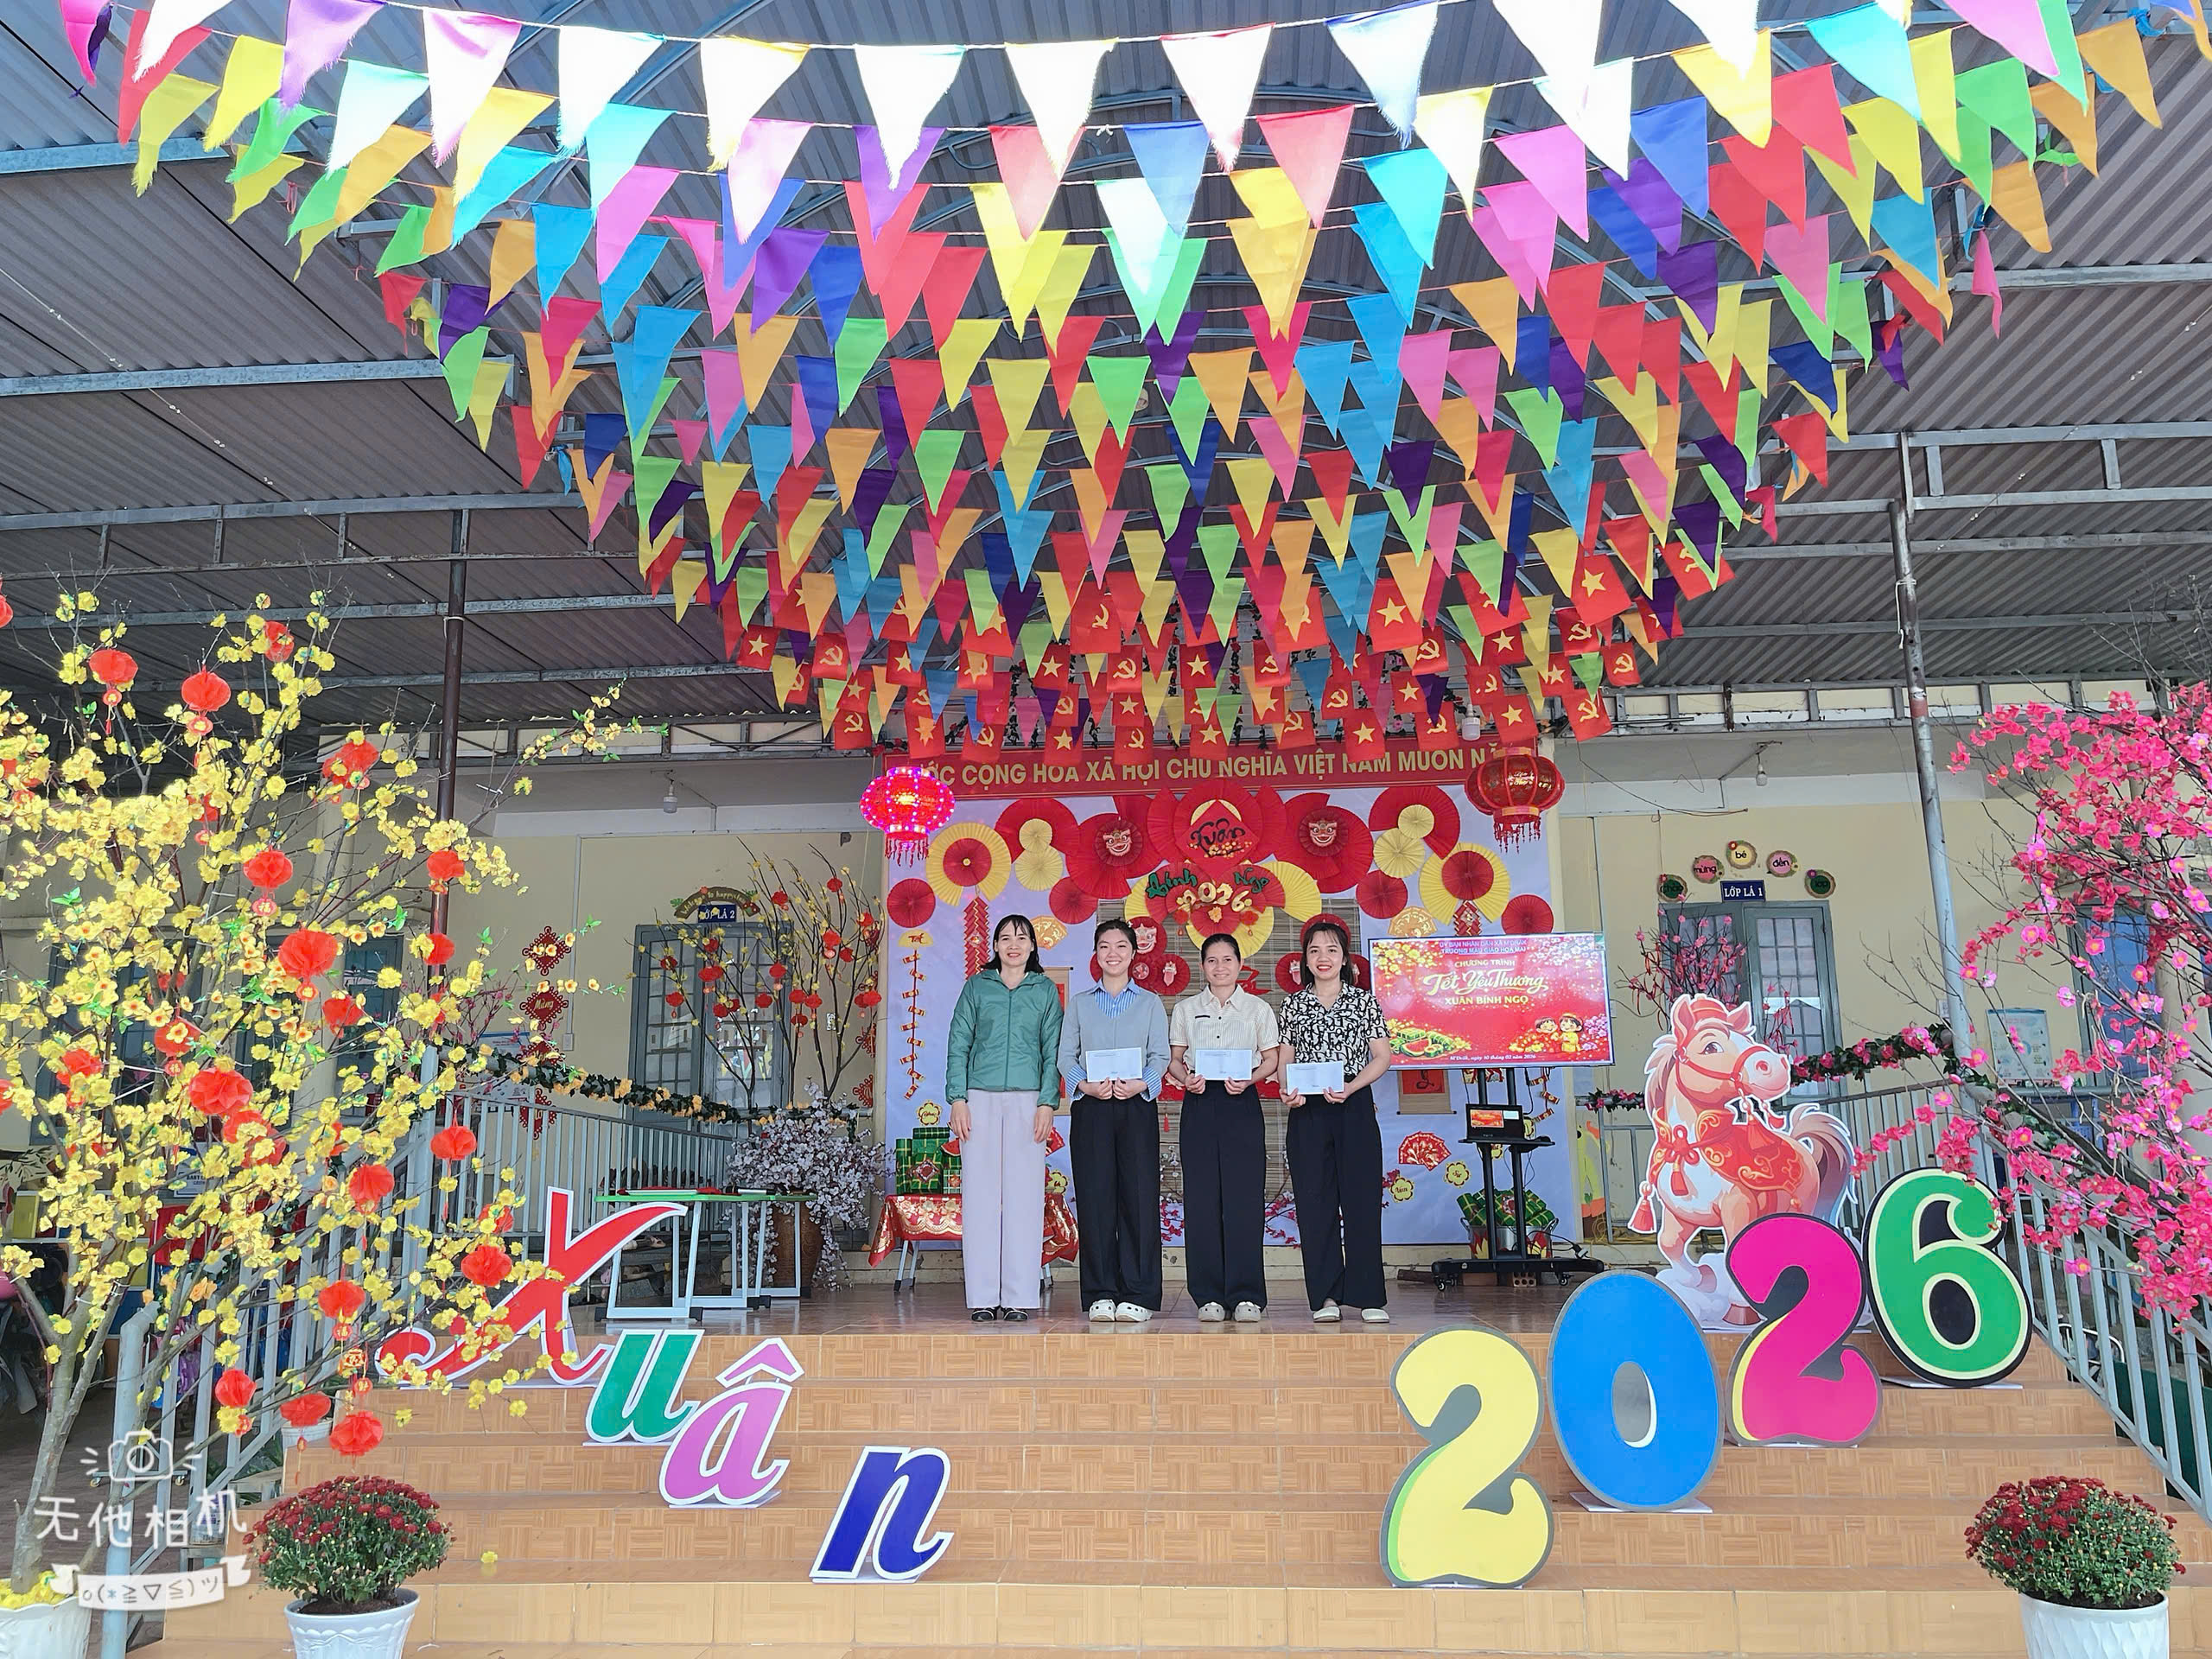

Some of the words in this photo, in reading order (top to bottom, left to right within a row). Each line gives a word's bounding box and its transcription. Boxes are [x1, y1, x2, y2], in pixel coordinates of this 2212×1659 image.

[1085, 756, 1116, 781] XÃ
[1218, 751, 1287, 777] NGHĨA
[1294, 747, 1336, 780] VIỆT
[1342, 752, 1391, 773] NAM
[1191, 817, 1246, 850] Xuân
[1735, 850, 1747, 859] bé
[1176, 881, 1251, 912] 2026
[1724, 886, 1742, 898] LỚP
[1743, 886, 1755, 897] LÁ
[1758, 887, 1764, 897] 1
[729, 910, 735, 919] 2
[1454, 959, 1489, 968] CHƯƠNG
[1491, 958, 1516, 967] TRÌNH
[1423, 970, 1461, 996] Tết
[1445, 995, 1473, 1006] XUÂN
[1476, 994, 1502, 1005] BÍNH
[1503, 995, 1529, 1006] NGỌ
[1381, 1166, 2033, 1587] 2026
